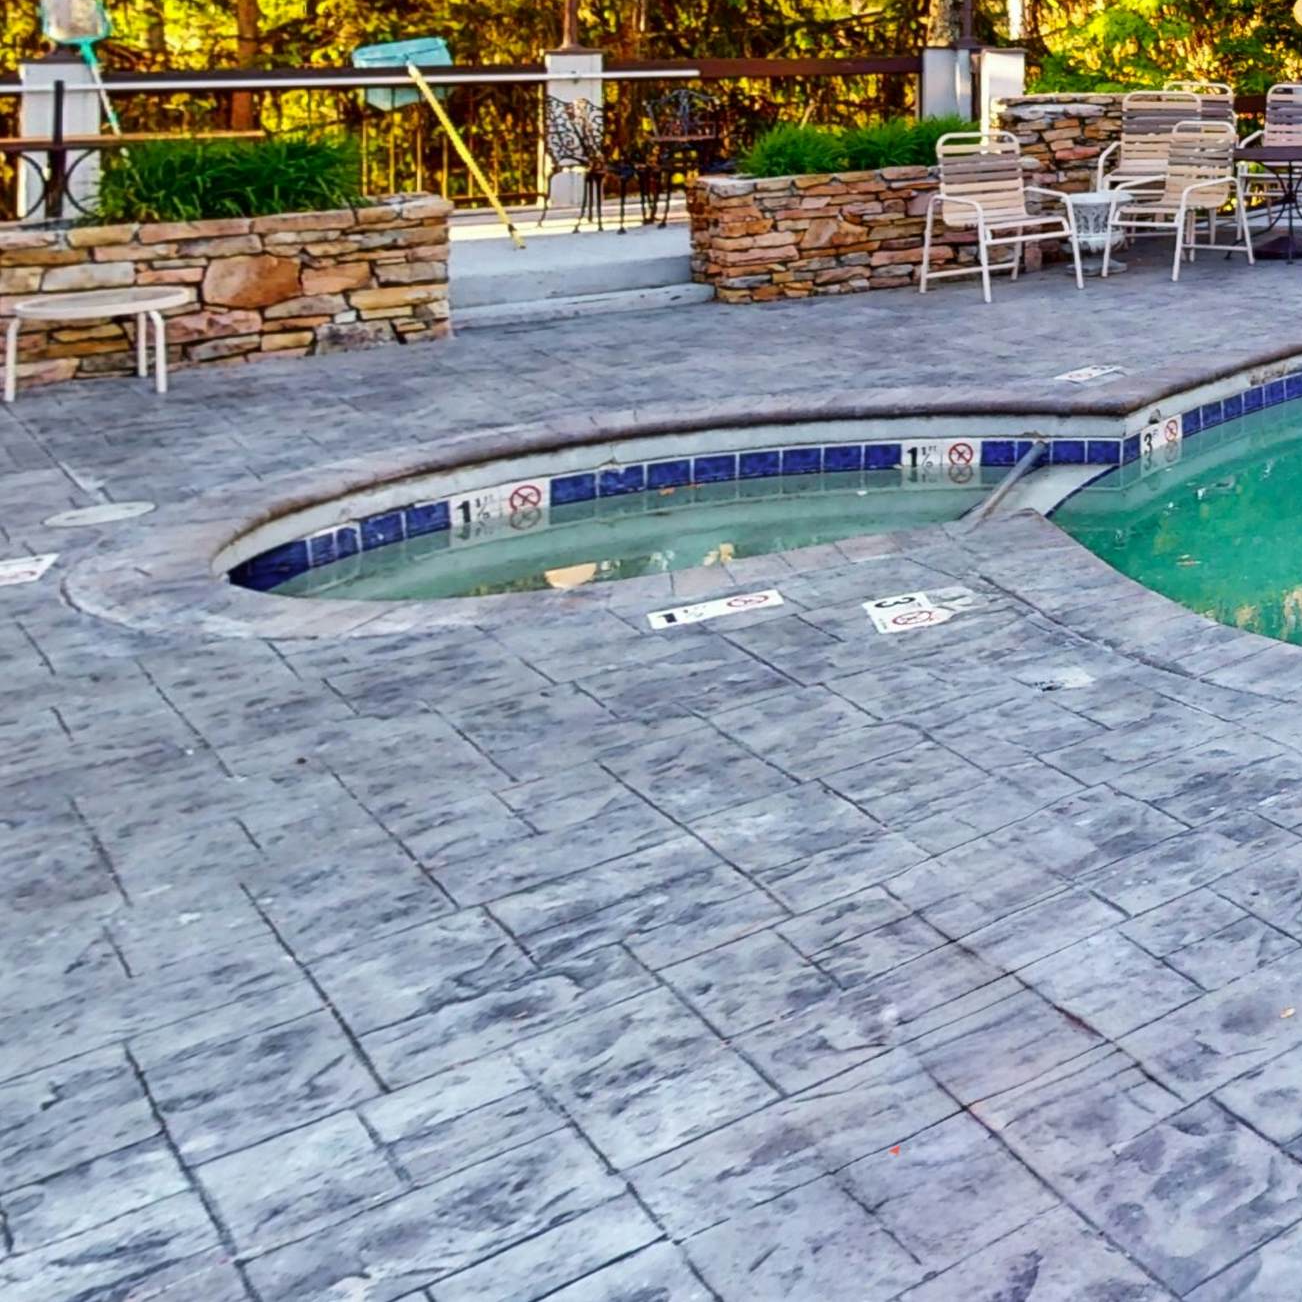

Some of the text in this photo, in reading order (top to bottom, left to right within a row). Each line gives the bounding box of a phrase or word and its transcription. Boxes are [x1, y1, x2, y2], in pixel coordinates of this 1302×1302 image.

[1144, 432, 1152, 456] 3
[907, 446, 918, 468] 1
[456, 500, 471, 523] 1
